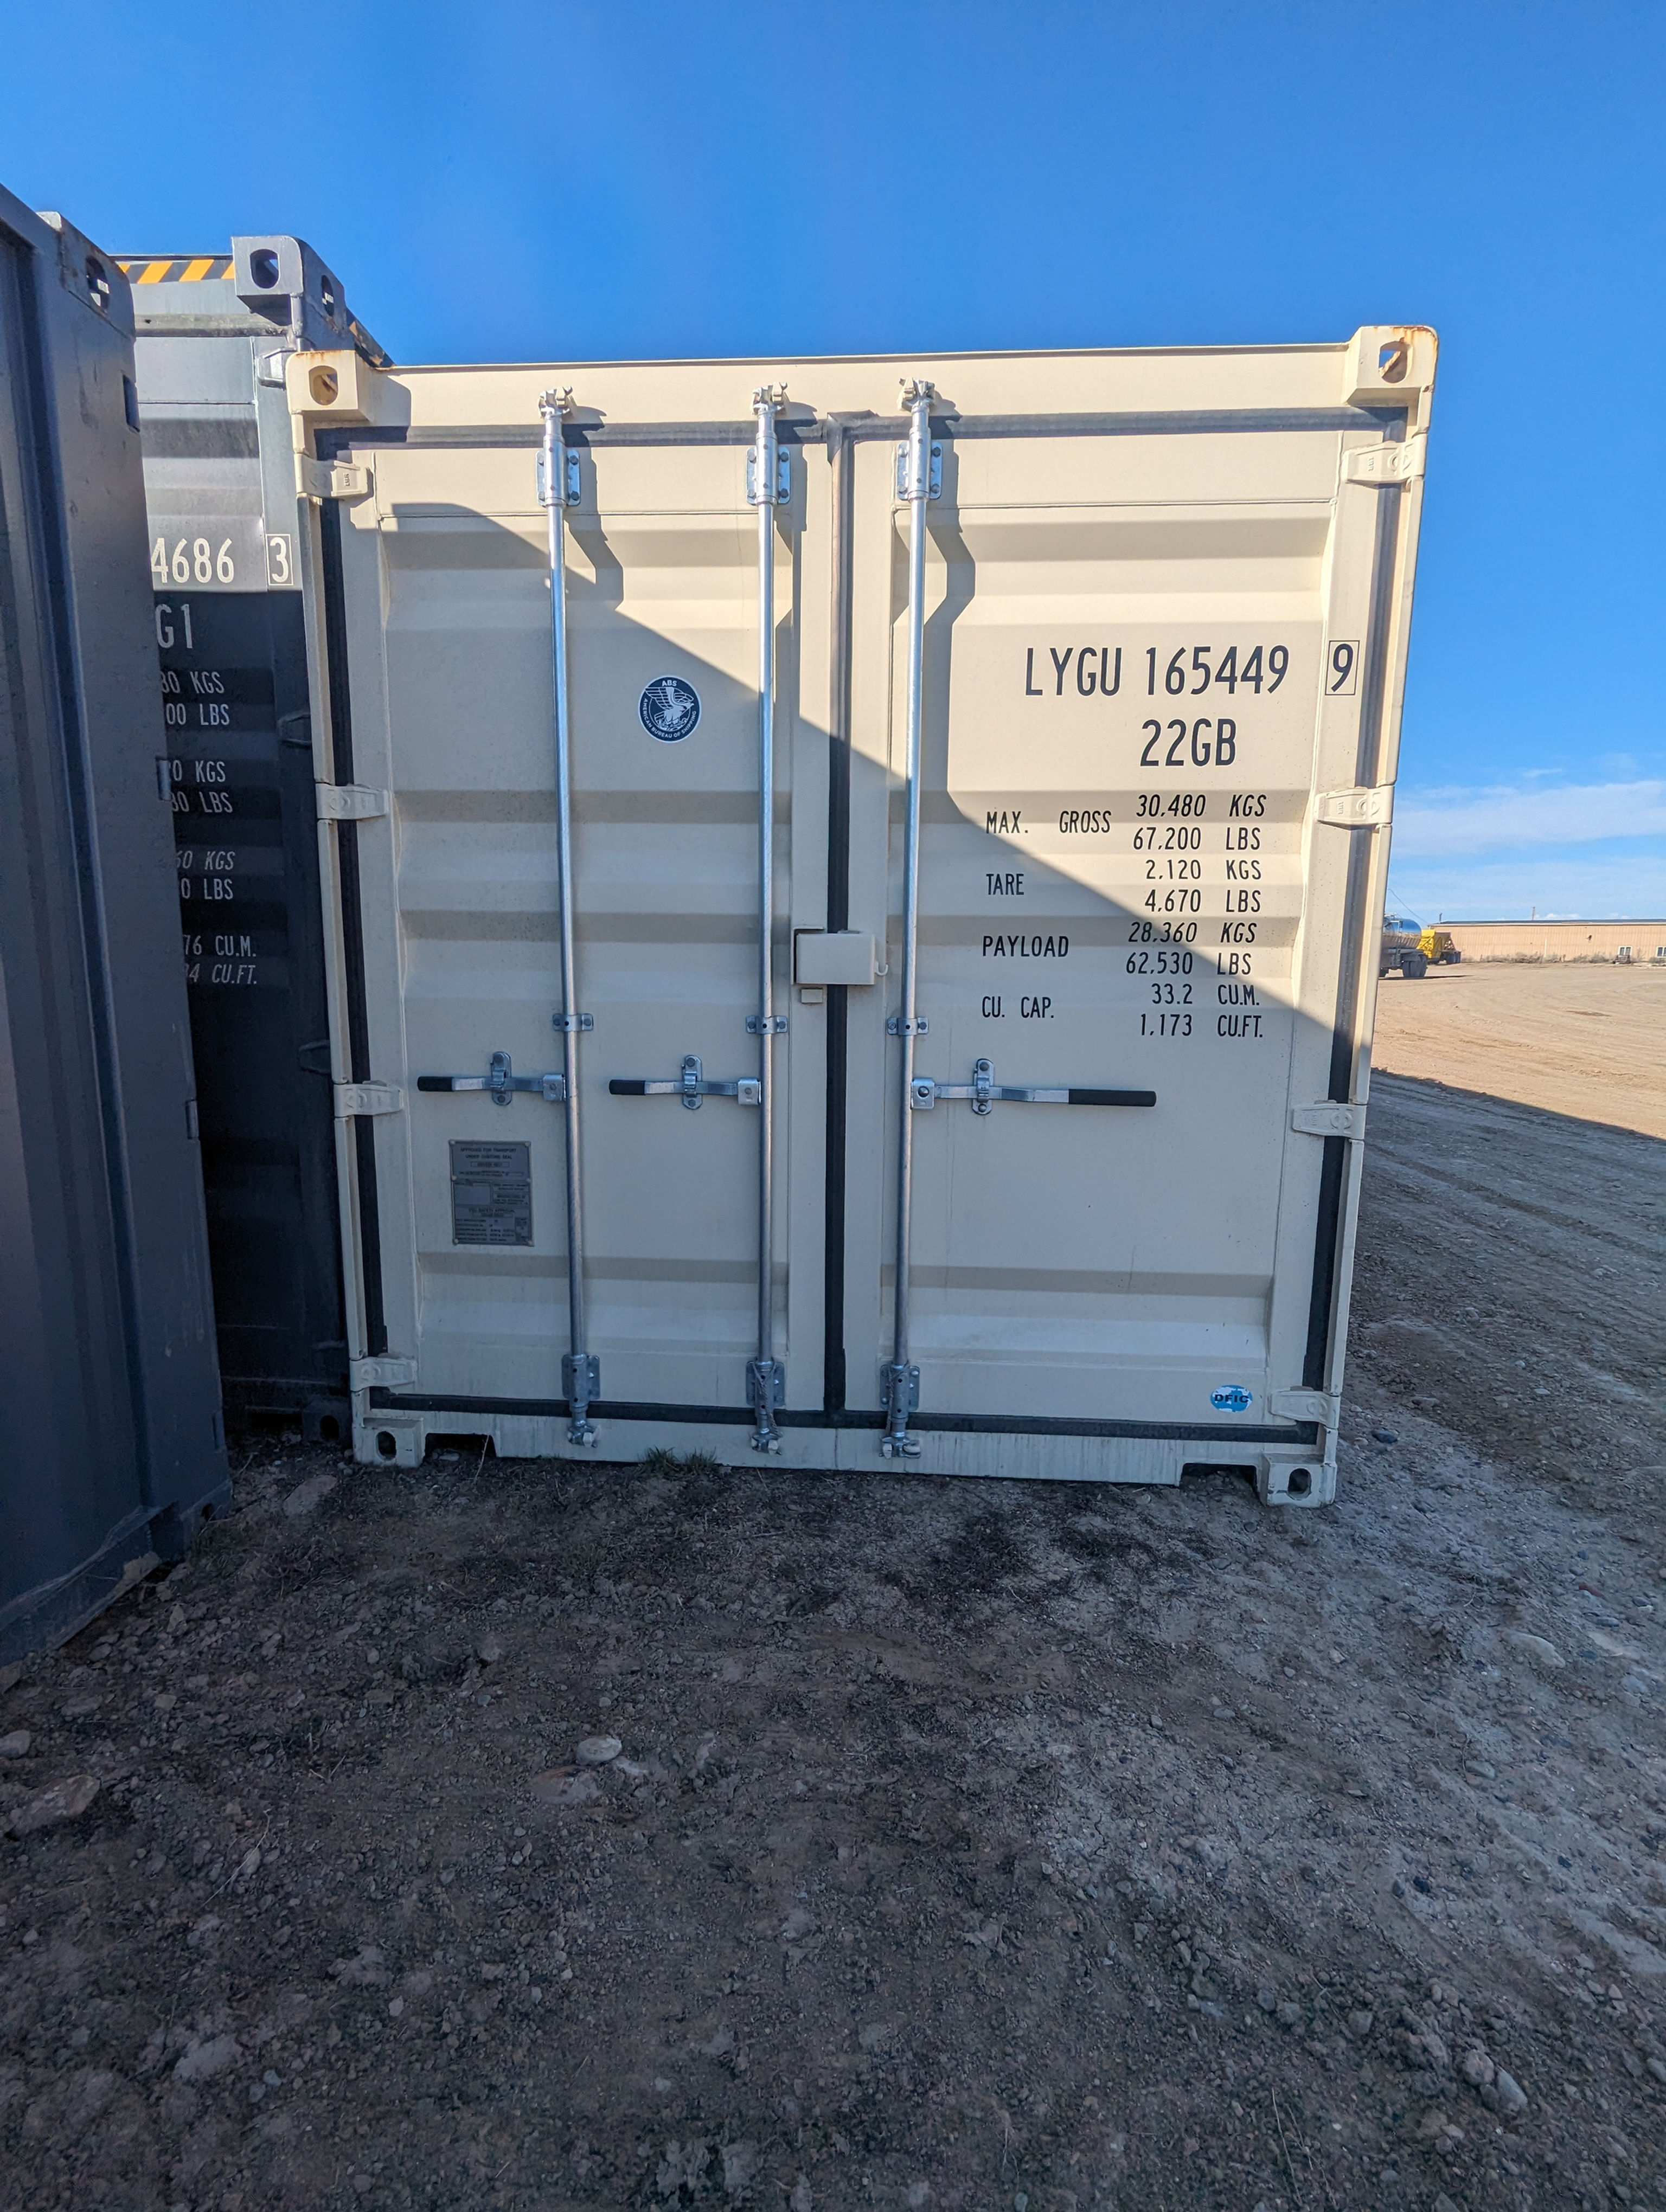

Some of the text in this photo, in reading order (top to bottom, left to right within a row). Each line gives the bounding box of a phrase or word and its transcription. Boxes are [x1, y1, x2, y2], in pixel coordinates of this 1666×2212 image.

[151, 537, 290, 583] 4686 3
[154, 603, 193, 649] G1
[1025, 643, 1354, 697] LYGU 165449 9
[190, 671, 225, 694] KGS
[165, 703, 230, 725] 00 LBS
[642, 698, 652, 729] AMERICAN
[651, 726, 672, 738] BUREAU
[682, 710, 697, 735] SHIPPING
[1140, 718, 1236, 767] 22GB
[195, 760, 226, 783] KGS
[198, 791, 233, 813] LBS
[1136, 794, 1267, 818] 30,480 KGS
[986, 810, 1112, 834] MAX. GROSS
[1133, 826, 1261, 851] 67,200 LBS
[204, 850, 236, 871] KGS
[1145, 859, 1261, 880] 2,120 KGS
[203, 878, 234, 900] LBS
[985, 873, 1024, 896] TARE
[1144, 889, 1261, 913] 4,670 LBS
[1127, 921, 1257, 943] 28,360 KGS
[183, 934, 257, 957] 76 CU.M.
[982, 935, 1069, 957] PAYLOAD
[211, 963, 258, 985] CU.FT.
[1126, 951, 1252, 975] 62,530 LBS
[1151, 982, 1260, 1006] 33.2 CU.M.
[982, 995, 1054, 1019] CU. CAP.
[1140, 1013, 1263, 1038] 1,173 CU.FT.
[1214, 1394, 1249, 1403] DFIC
